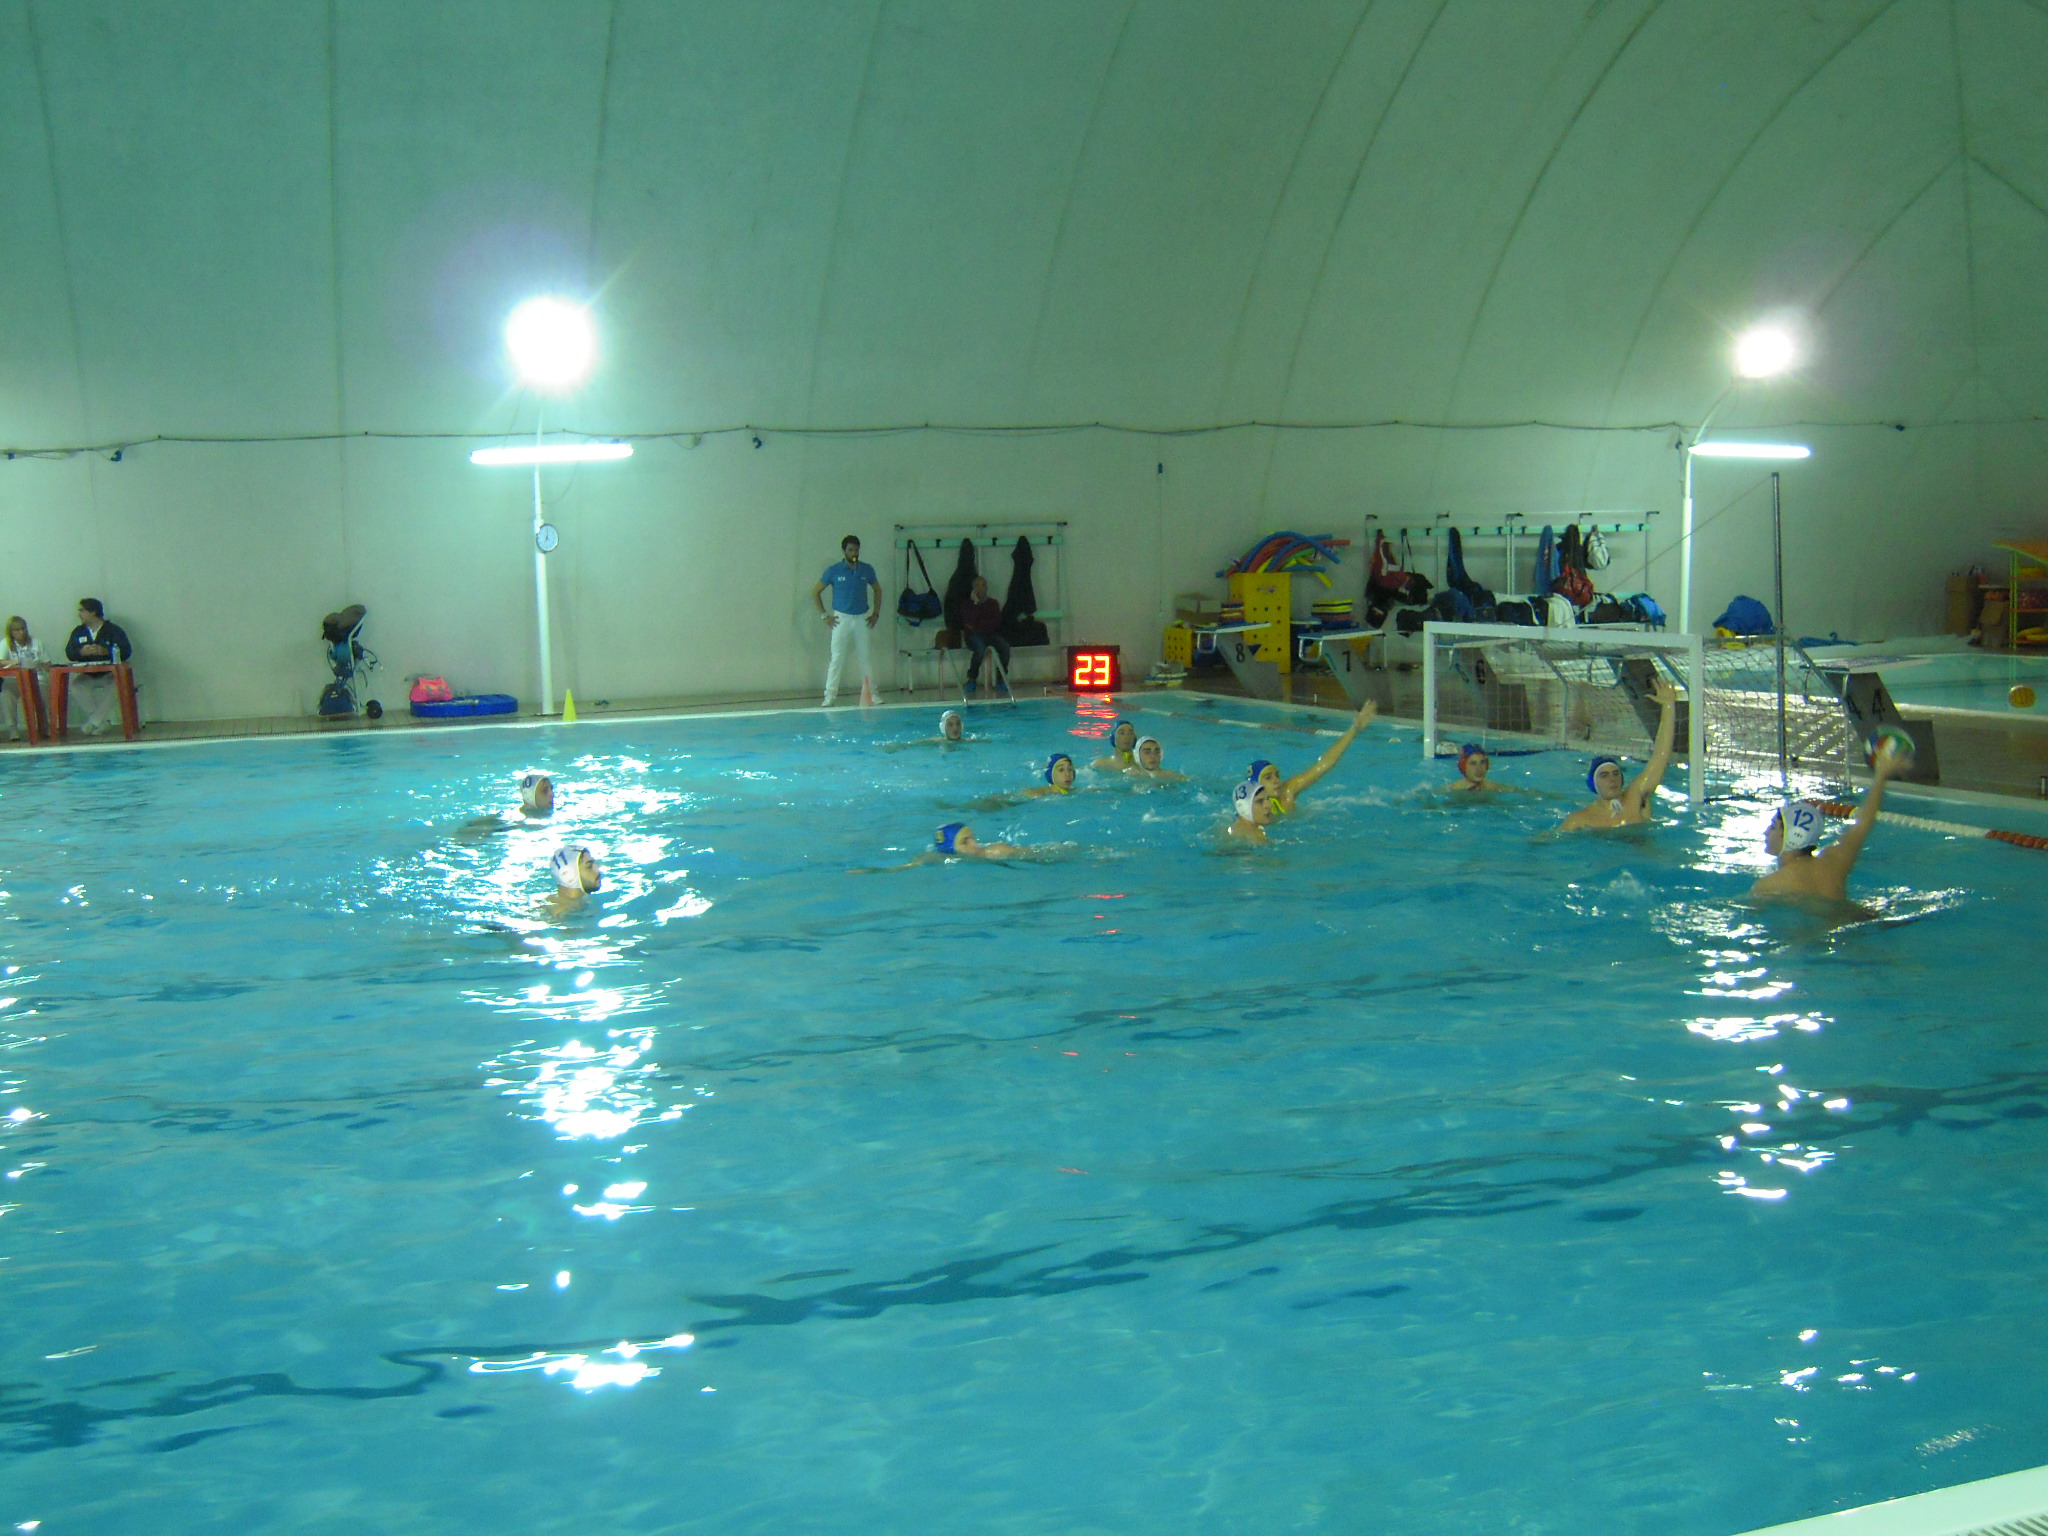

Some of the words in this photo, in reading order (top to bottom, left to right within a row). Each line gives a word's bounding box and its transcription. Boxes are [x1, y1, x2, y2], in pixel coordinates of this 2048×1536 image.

[1235, 642, 1246, 663] 8
[1075, 655, 1110, 685] 23
[1872, 687, 1885, 721] 4
[1235, 785, 1247, 800] 13
[1793, 809, 1814, 832] 12
[553, 850, 568, 870] 11
